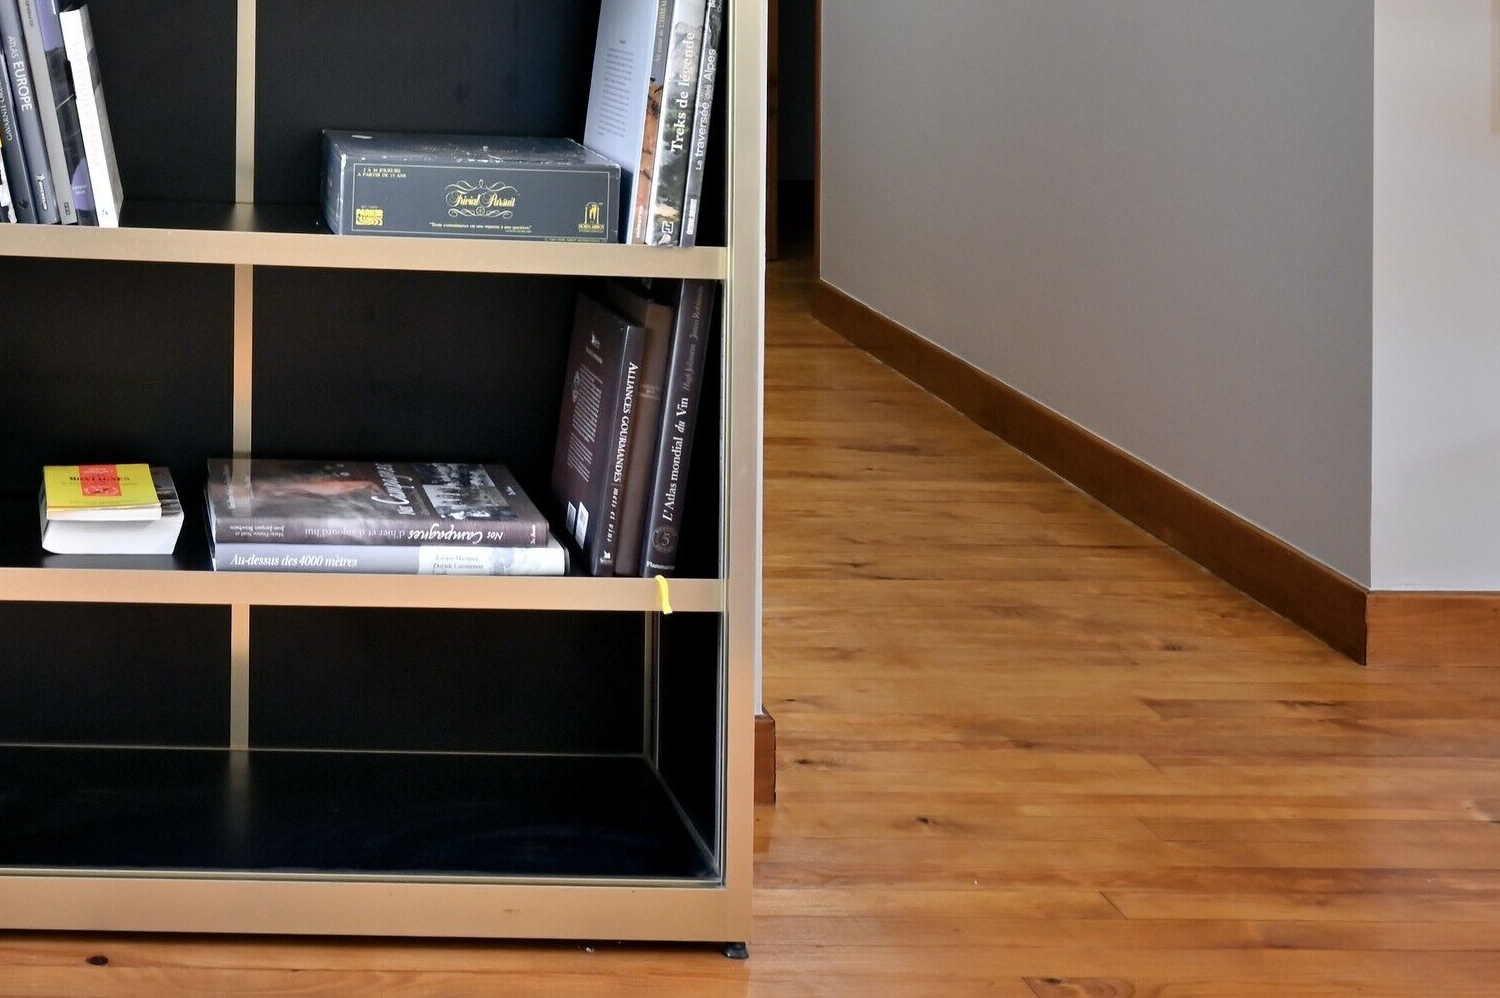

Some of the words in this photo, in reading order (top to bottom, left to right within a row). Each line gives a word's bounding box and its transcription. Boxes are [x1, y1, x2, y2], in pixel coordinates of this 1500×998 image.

[678, 32, 695, 86] légende
[8, 36, 18, 59] ATLAS
[13, 61, 32, 111] EUROPE
[677, 90, 689, 108] de
[695, 101, 710, 158] traversée
[703, 49, 717, 82] Alpes
[670, 114, 687, 153] Treks
[446, 192, 481, 208] Trivial
[483, 192, 516, 208] Pursuit
[622, 361, 639, 415] ALLIANCES
[676, 397, 689, 416] Vin
[674, 420, 685, 433] du
[613, 415, 631, 483] GOURMANDES
[670, 436, 683, 481] mondial
[662, 483, 677, 522] L'Atlas
[379, 529, 405, 539] d'hier
[408, 523, 483, 544] Campagnes
[487, 531, 503, 540] Nos
[607, 521, 616, 542] vins
[230, 554, 279, 567] Au-dessus
[281, 555, 298, 567] des
[299, 556, 323, 567] 4000
[325, 556, 358, 568] mètres
